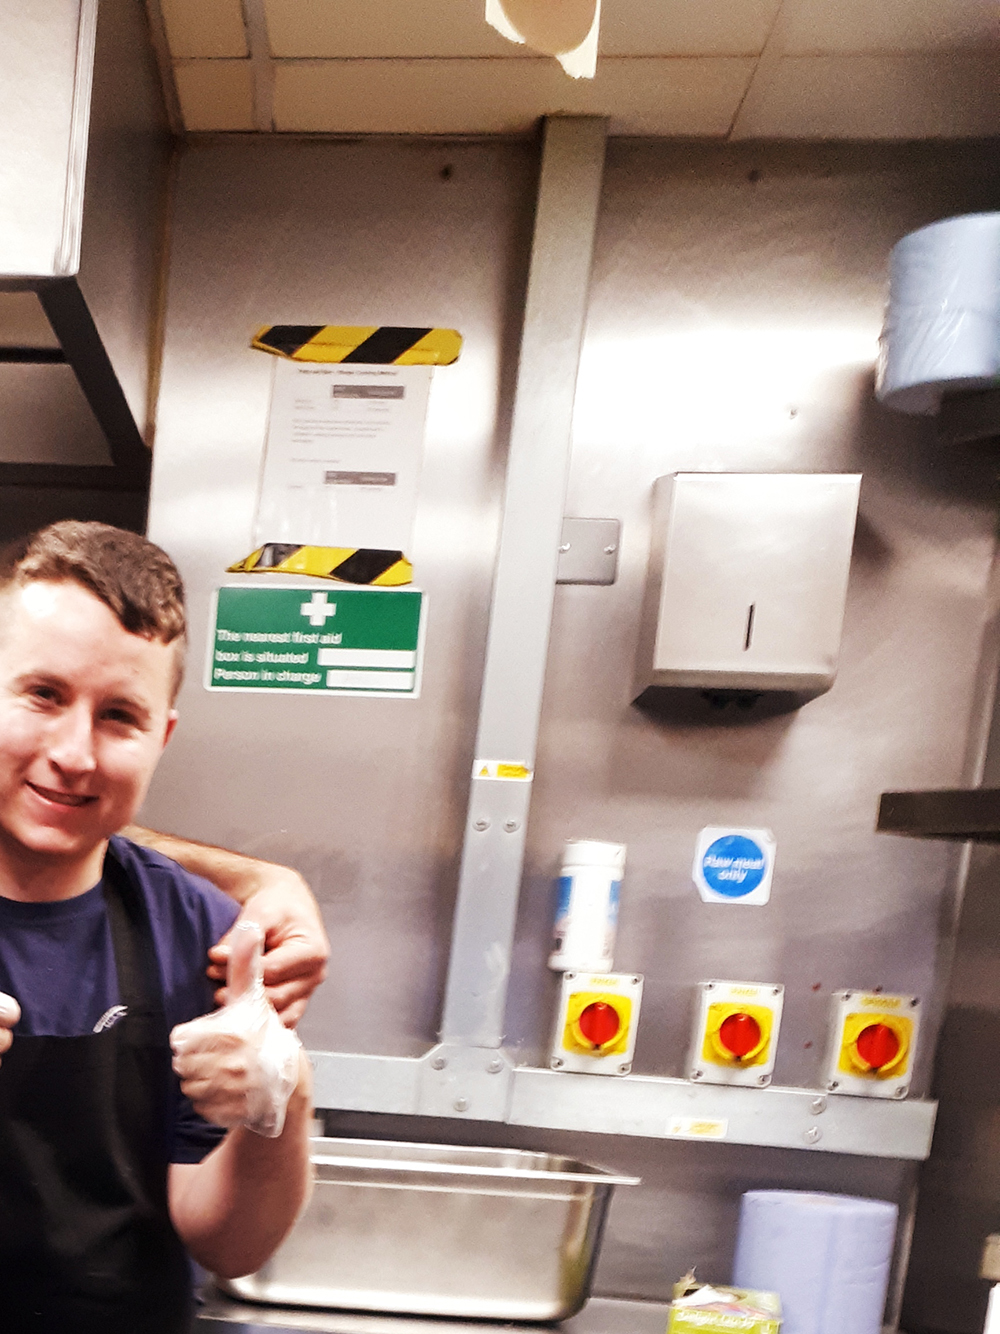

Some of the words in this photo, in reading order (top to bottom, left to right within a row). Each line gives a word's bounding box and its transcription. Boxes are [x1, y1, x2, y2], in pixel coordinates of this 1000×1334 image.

[217, 629, 241, 642] The
[241, 632, 290, 643] nearest
[291, 631, 319, 644] first
[319, 632, 343, 644] aid
[215, 649, 240, 662] box
[241, 650, 255, 663] is
[255, 651, 309, 664] situated
[213, 667, 260, 681] Person
[260, 668, 275, 681] in
[275, 670, 321, 685] charge
